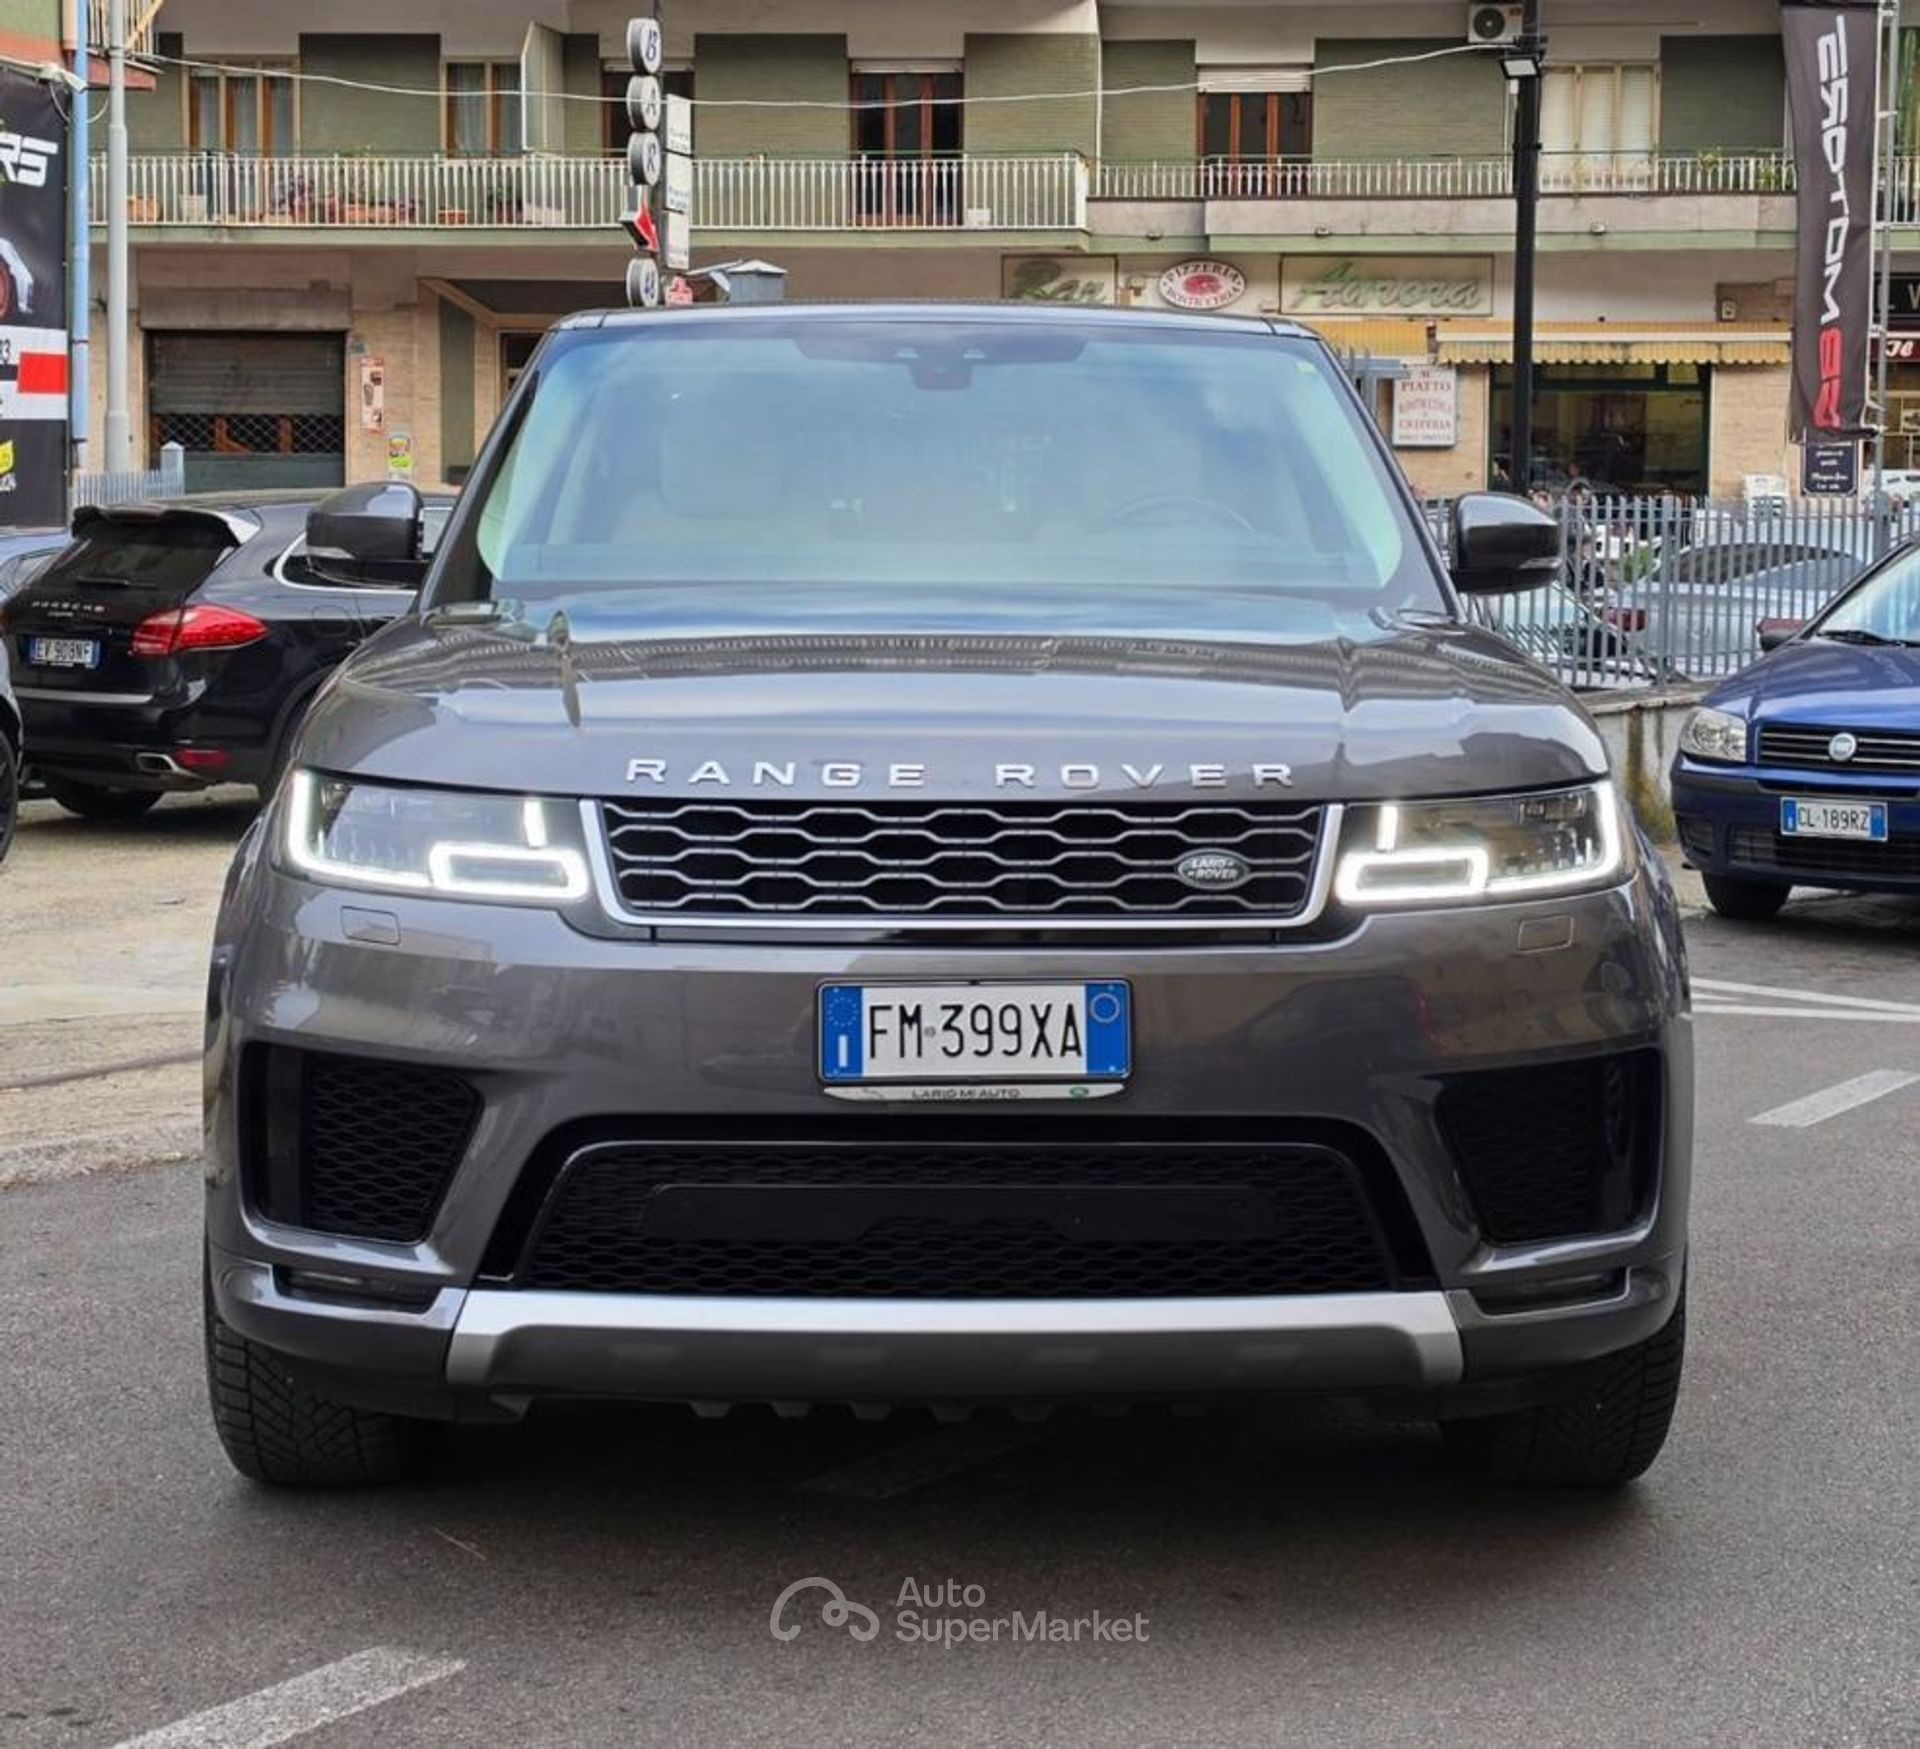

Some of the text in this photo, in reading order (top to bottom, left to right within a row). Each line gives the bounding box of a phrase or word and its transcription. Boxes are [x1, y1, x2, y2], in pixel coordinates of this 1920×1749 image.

[1165, 263, 1240, 281] PIZZERIA
[1400, 380, 1452, 392] PIATTO
[626, 759, 1295, 789] RANGE ROVER
[911, 1087, 958, 1099] LARIO
[979, 1087, 1021, 1098] AUTO
